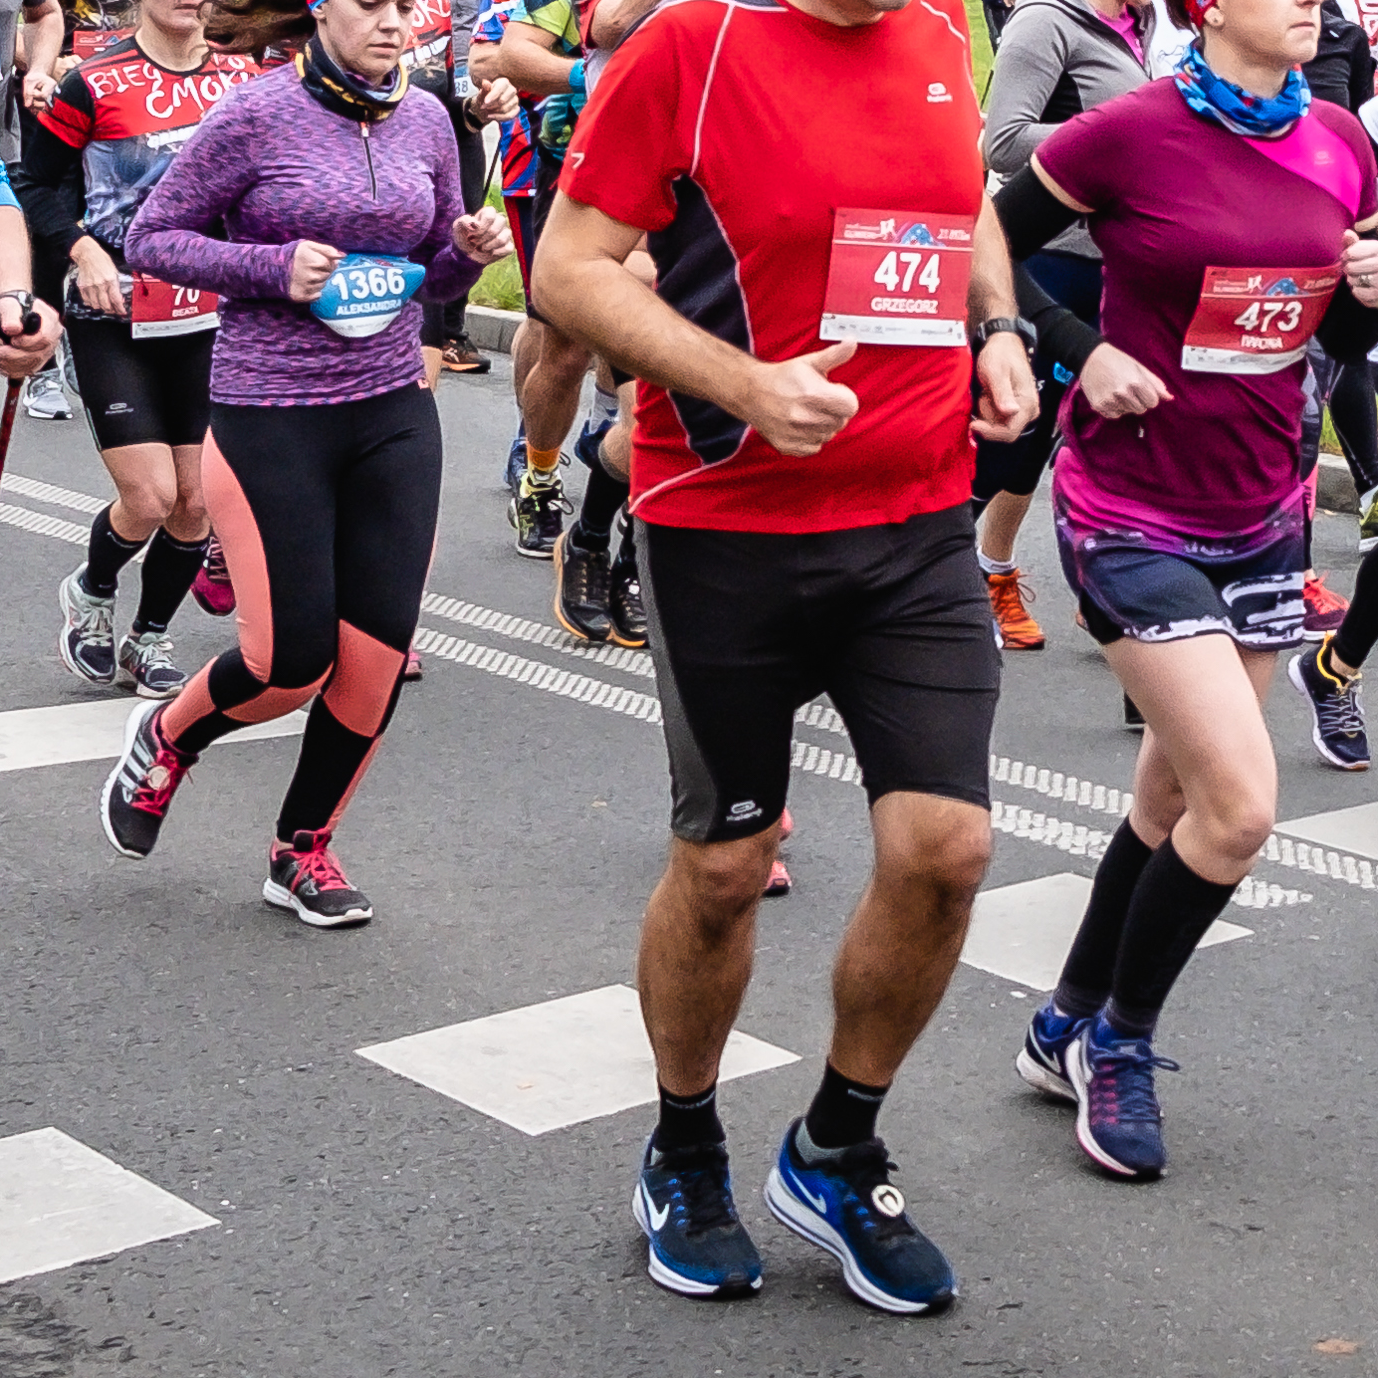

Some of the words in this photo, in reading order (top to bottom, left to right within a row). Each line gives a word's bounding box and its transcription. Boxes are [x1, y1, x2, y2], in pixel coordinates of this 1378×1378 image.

[331, 268, 405, 300] 1366
[874, 251, 940, 293] 474
[870, 297, 939, 314] GRZEGORZ
[1234, 301, 1303, 333] 473
